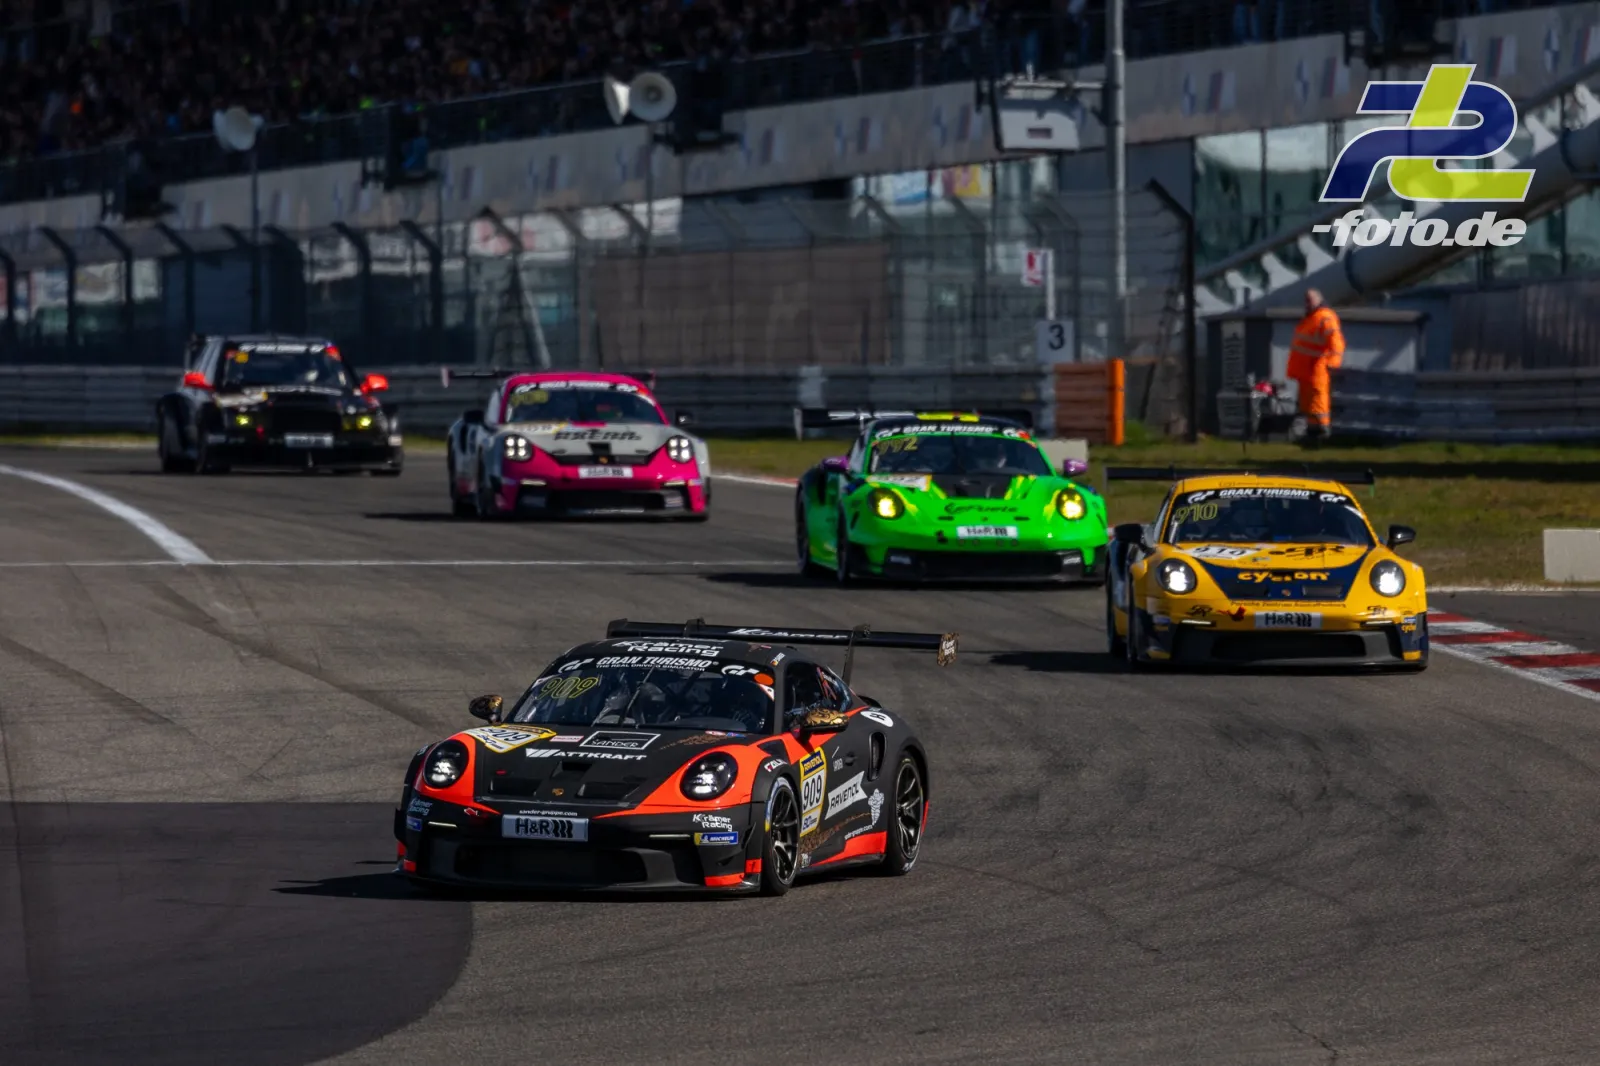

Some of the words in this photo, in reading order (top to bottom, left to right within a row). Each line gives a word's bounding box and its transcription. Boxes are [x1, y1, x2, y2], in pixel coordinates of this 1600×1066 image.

[1049, 324, 1065, 350] 3
[903, 425, 937, 433] GRAN
[940, 425, 994, 433] TURISMO
[1219, 488, 1253, 497] GRAN
[1175, 502, 1219, 525] 910
[627, 646, 720, 658] Racing
[597, 657, 642, 666] GRAN
[643, 657, 713, 668] TURISMO
[539, 676, 599, 699] 909
[803, 774, 823, 811] 909
[515, 817, 550, 836] H&R
[702, 821, 733, 832] Racing
